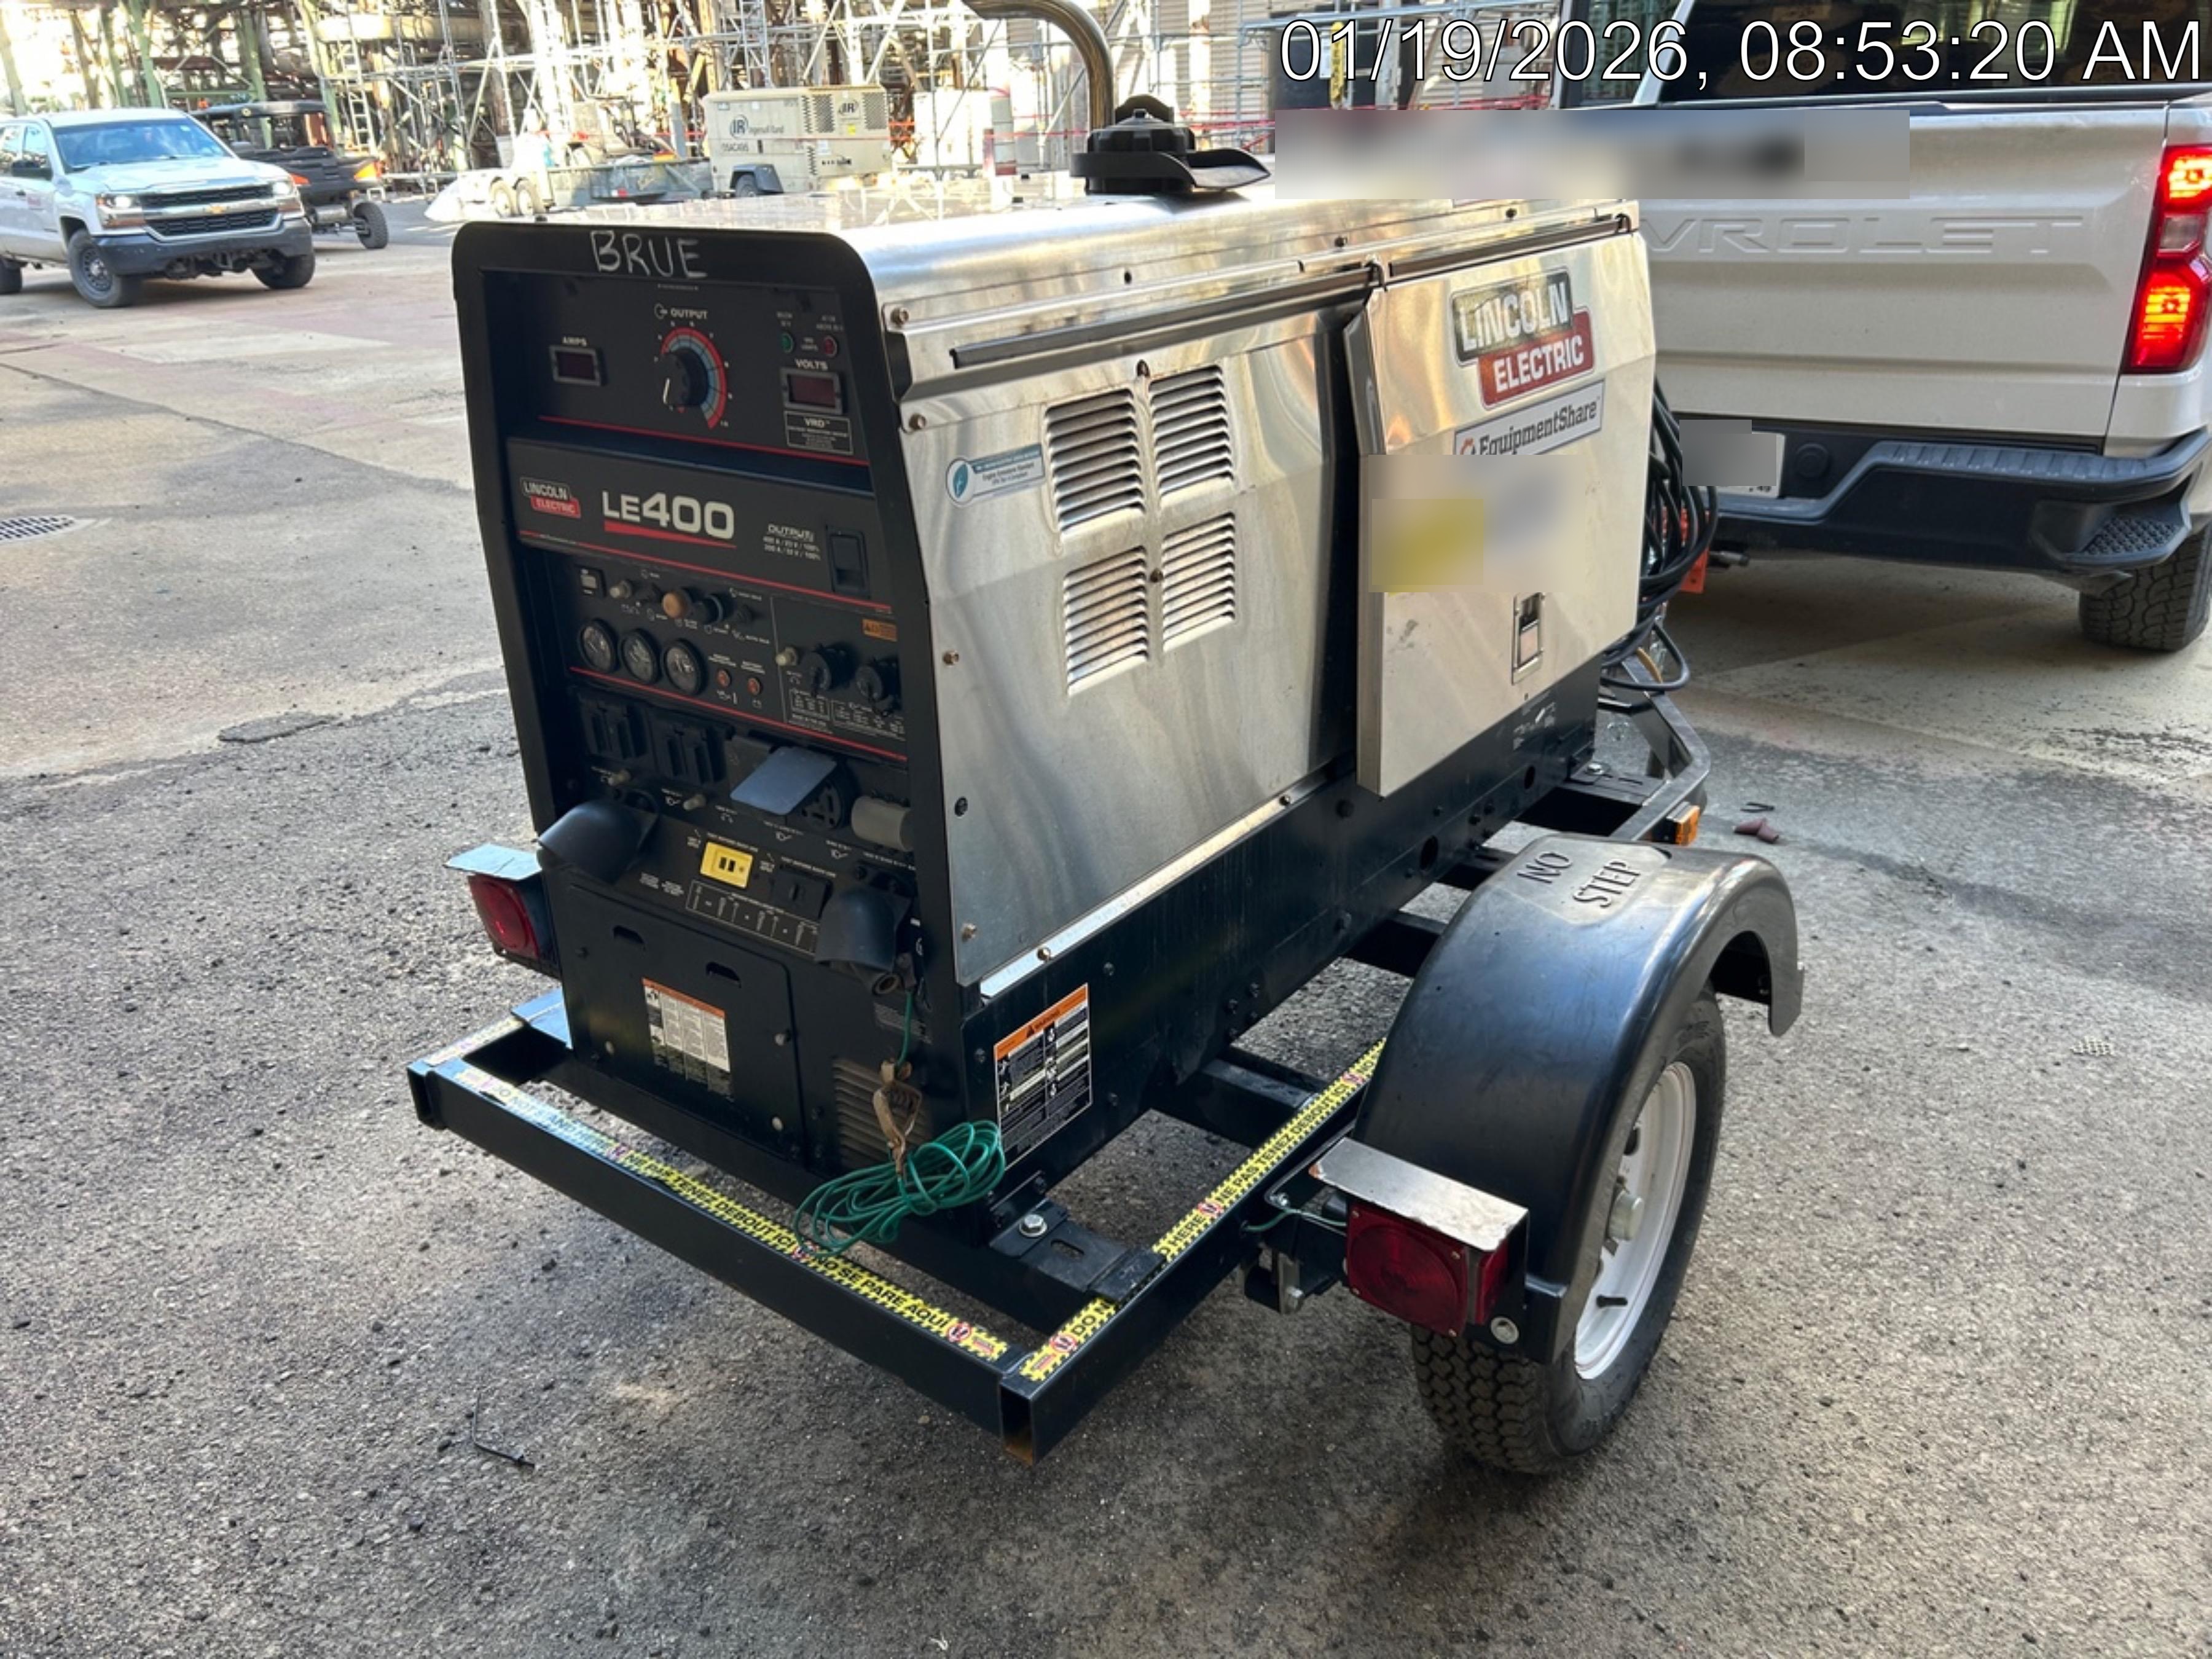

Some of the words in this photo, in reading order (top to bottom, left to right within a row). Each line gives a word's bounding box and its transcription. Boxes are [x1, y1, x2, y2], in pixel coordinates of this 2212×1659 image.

[590, 230, 708, 277] BRUE
[670, 309, 708, 320] OUTPUT
[1459, 281, 1568, 351] LINCOLN
[794, 358, 828, 371] VOLTS
[1493, 335, 1585, 393] ELECTRIC
[522, 480, 568, 501] LINCOLN
[602, 491, 734, 539] LE400
[1517, 852, 1572, 884] NO
[1572, 860, 1641, 908] STEP
[715, 1200, 774, 1237] DEBOUT
[774, 1233, 795, 1249] ICI
[1171, 1214, 1205, 1247] HERE
[838, 1267, 861, 1284] SE
[861, 1280, 908, 1309] PARE
[904, 1303, 949, 1331] AQUI
[1071, 1315, 1096, 1335] DO
